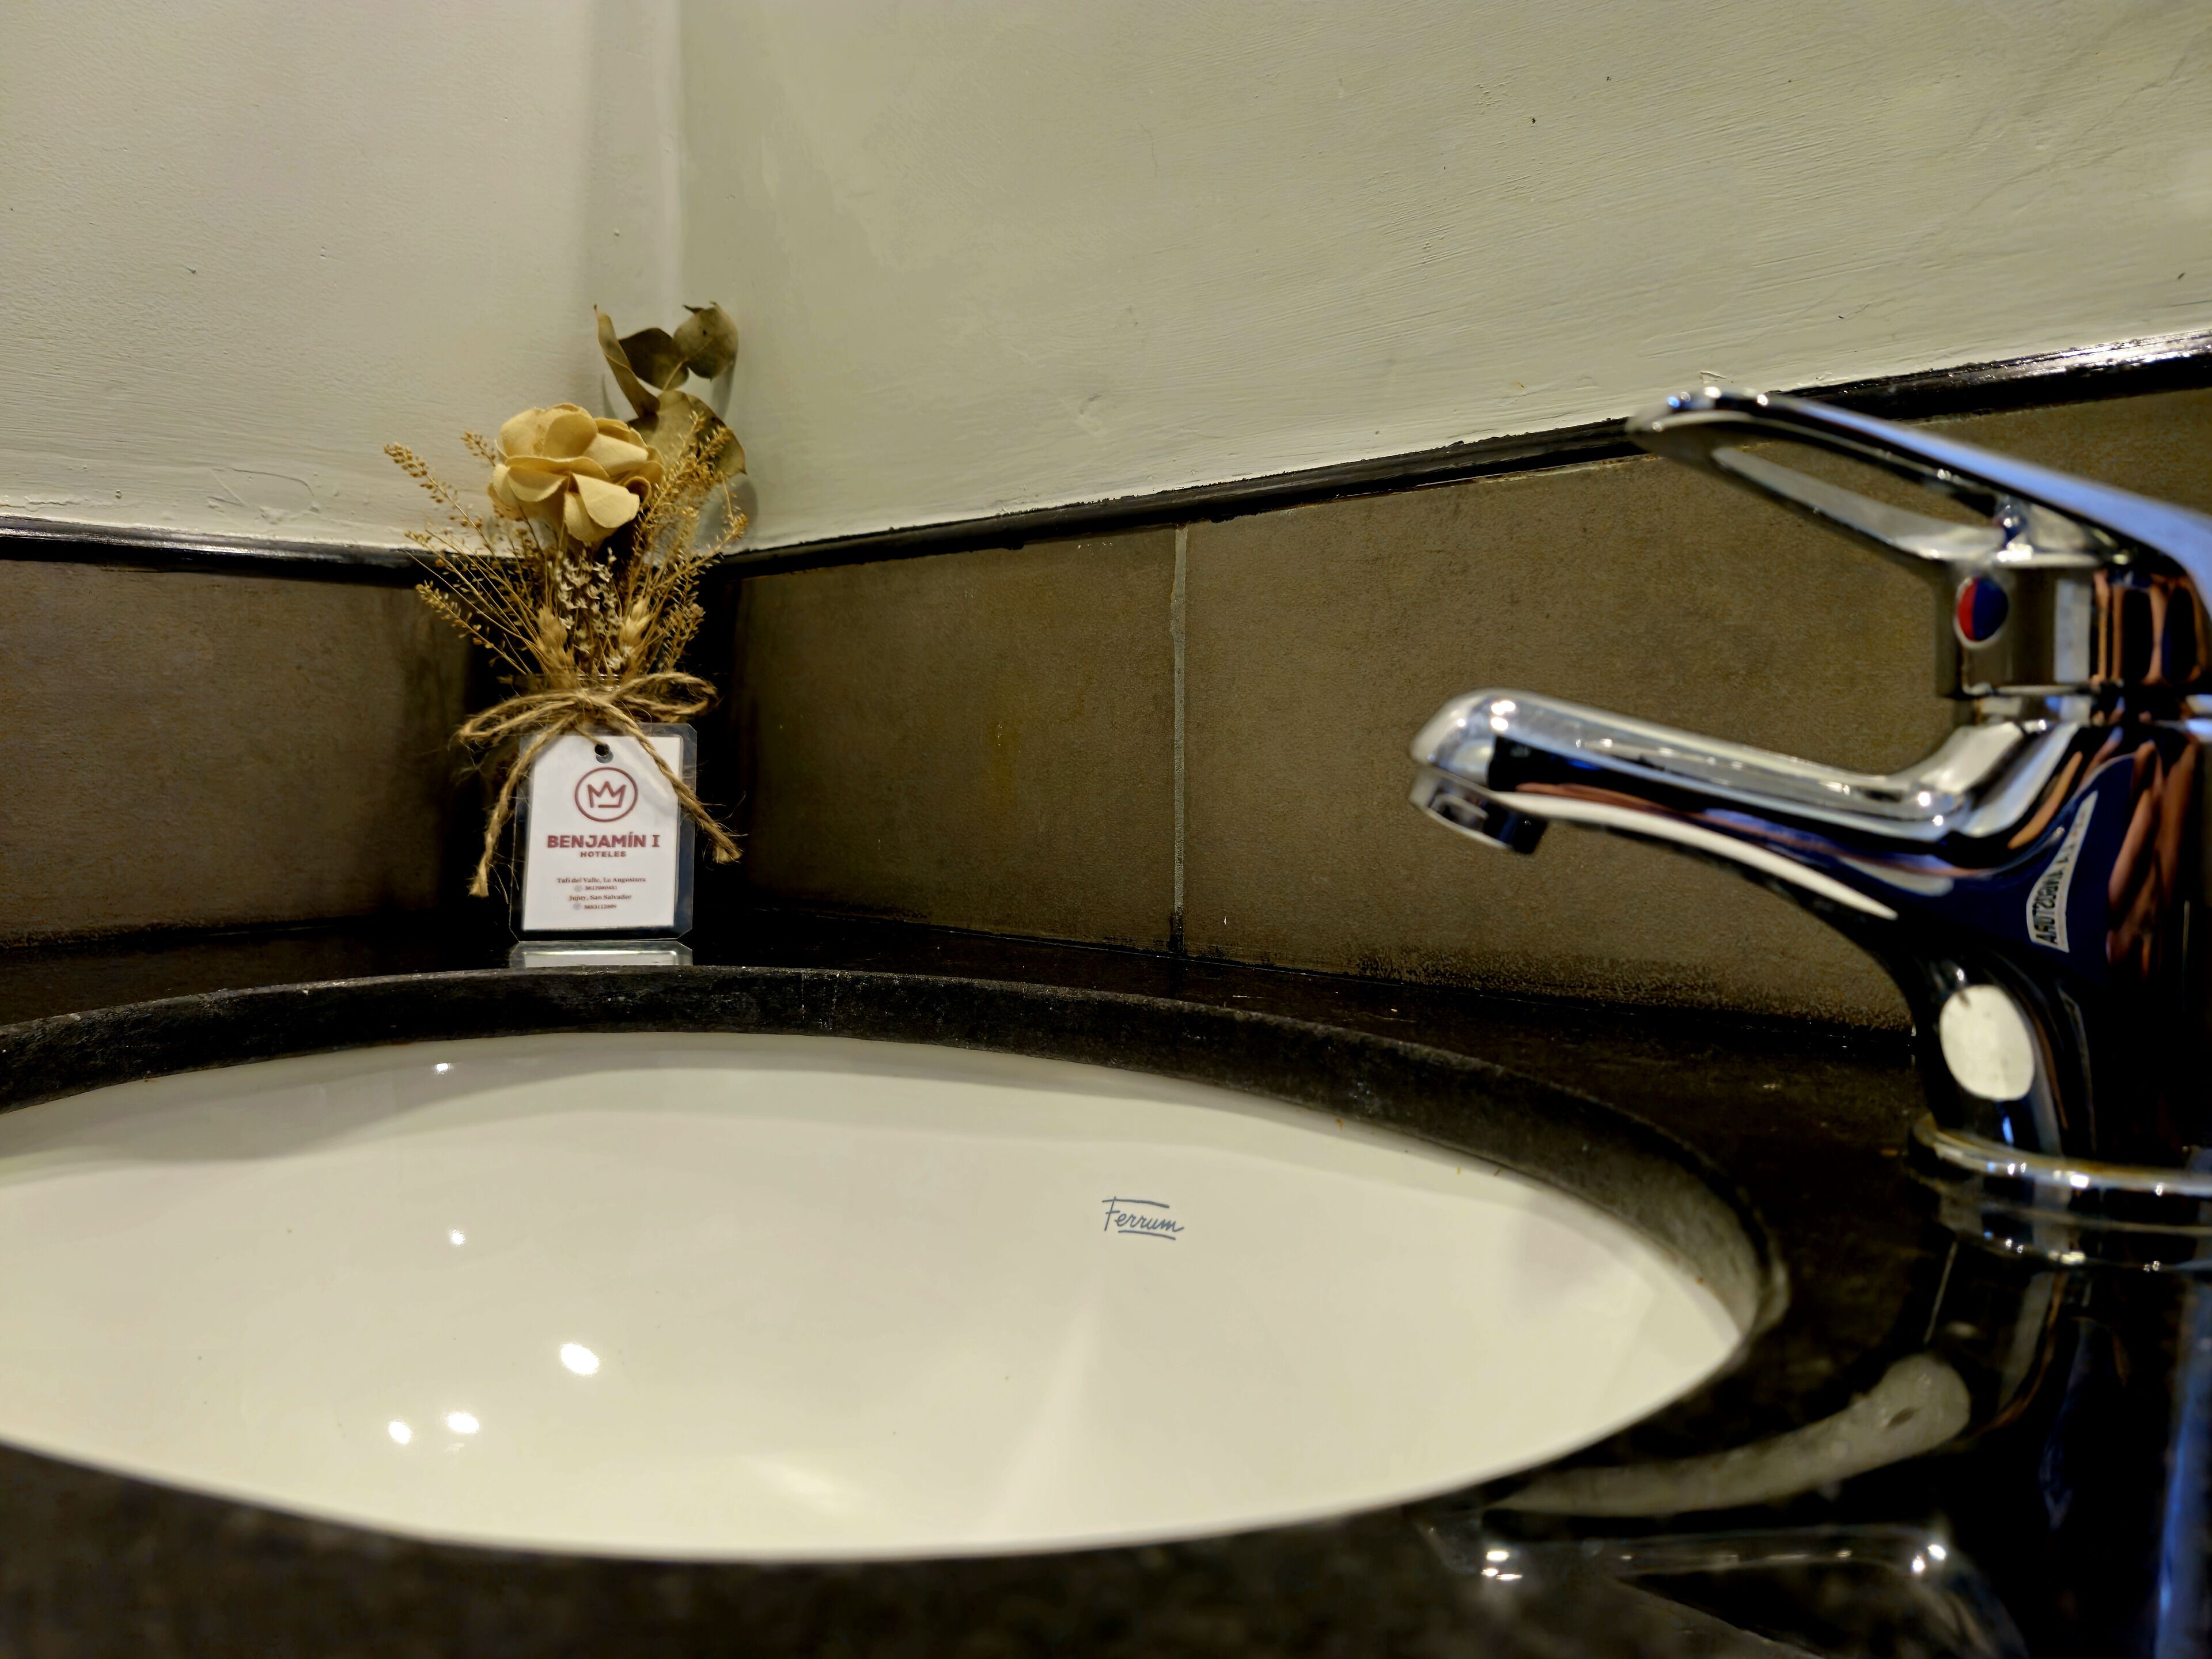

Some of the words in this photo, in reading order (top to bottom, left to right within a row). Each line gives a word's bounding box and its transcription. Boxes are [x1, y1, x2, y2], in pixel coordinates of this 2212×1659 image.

[547, 832, 646, 848] BENJAMÍN
[652, 835, 660, 847] I
[1102, 1196, 1184, 1233] Ferrum
